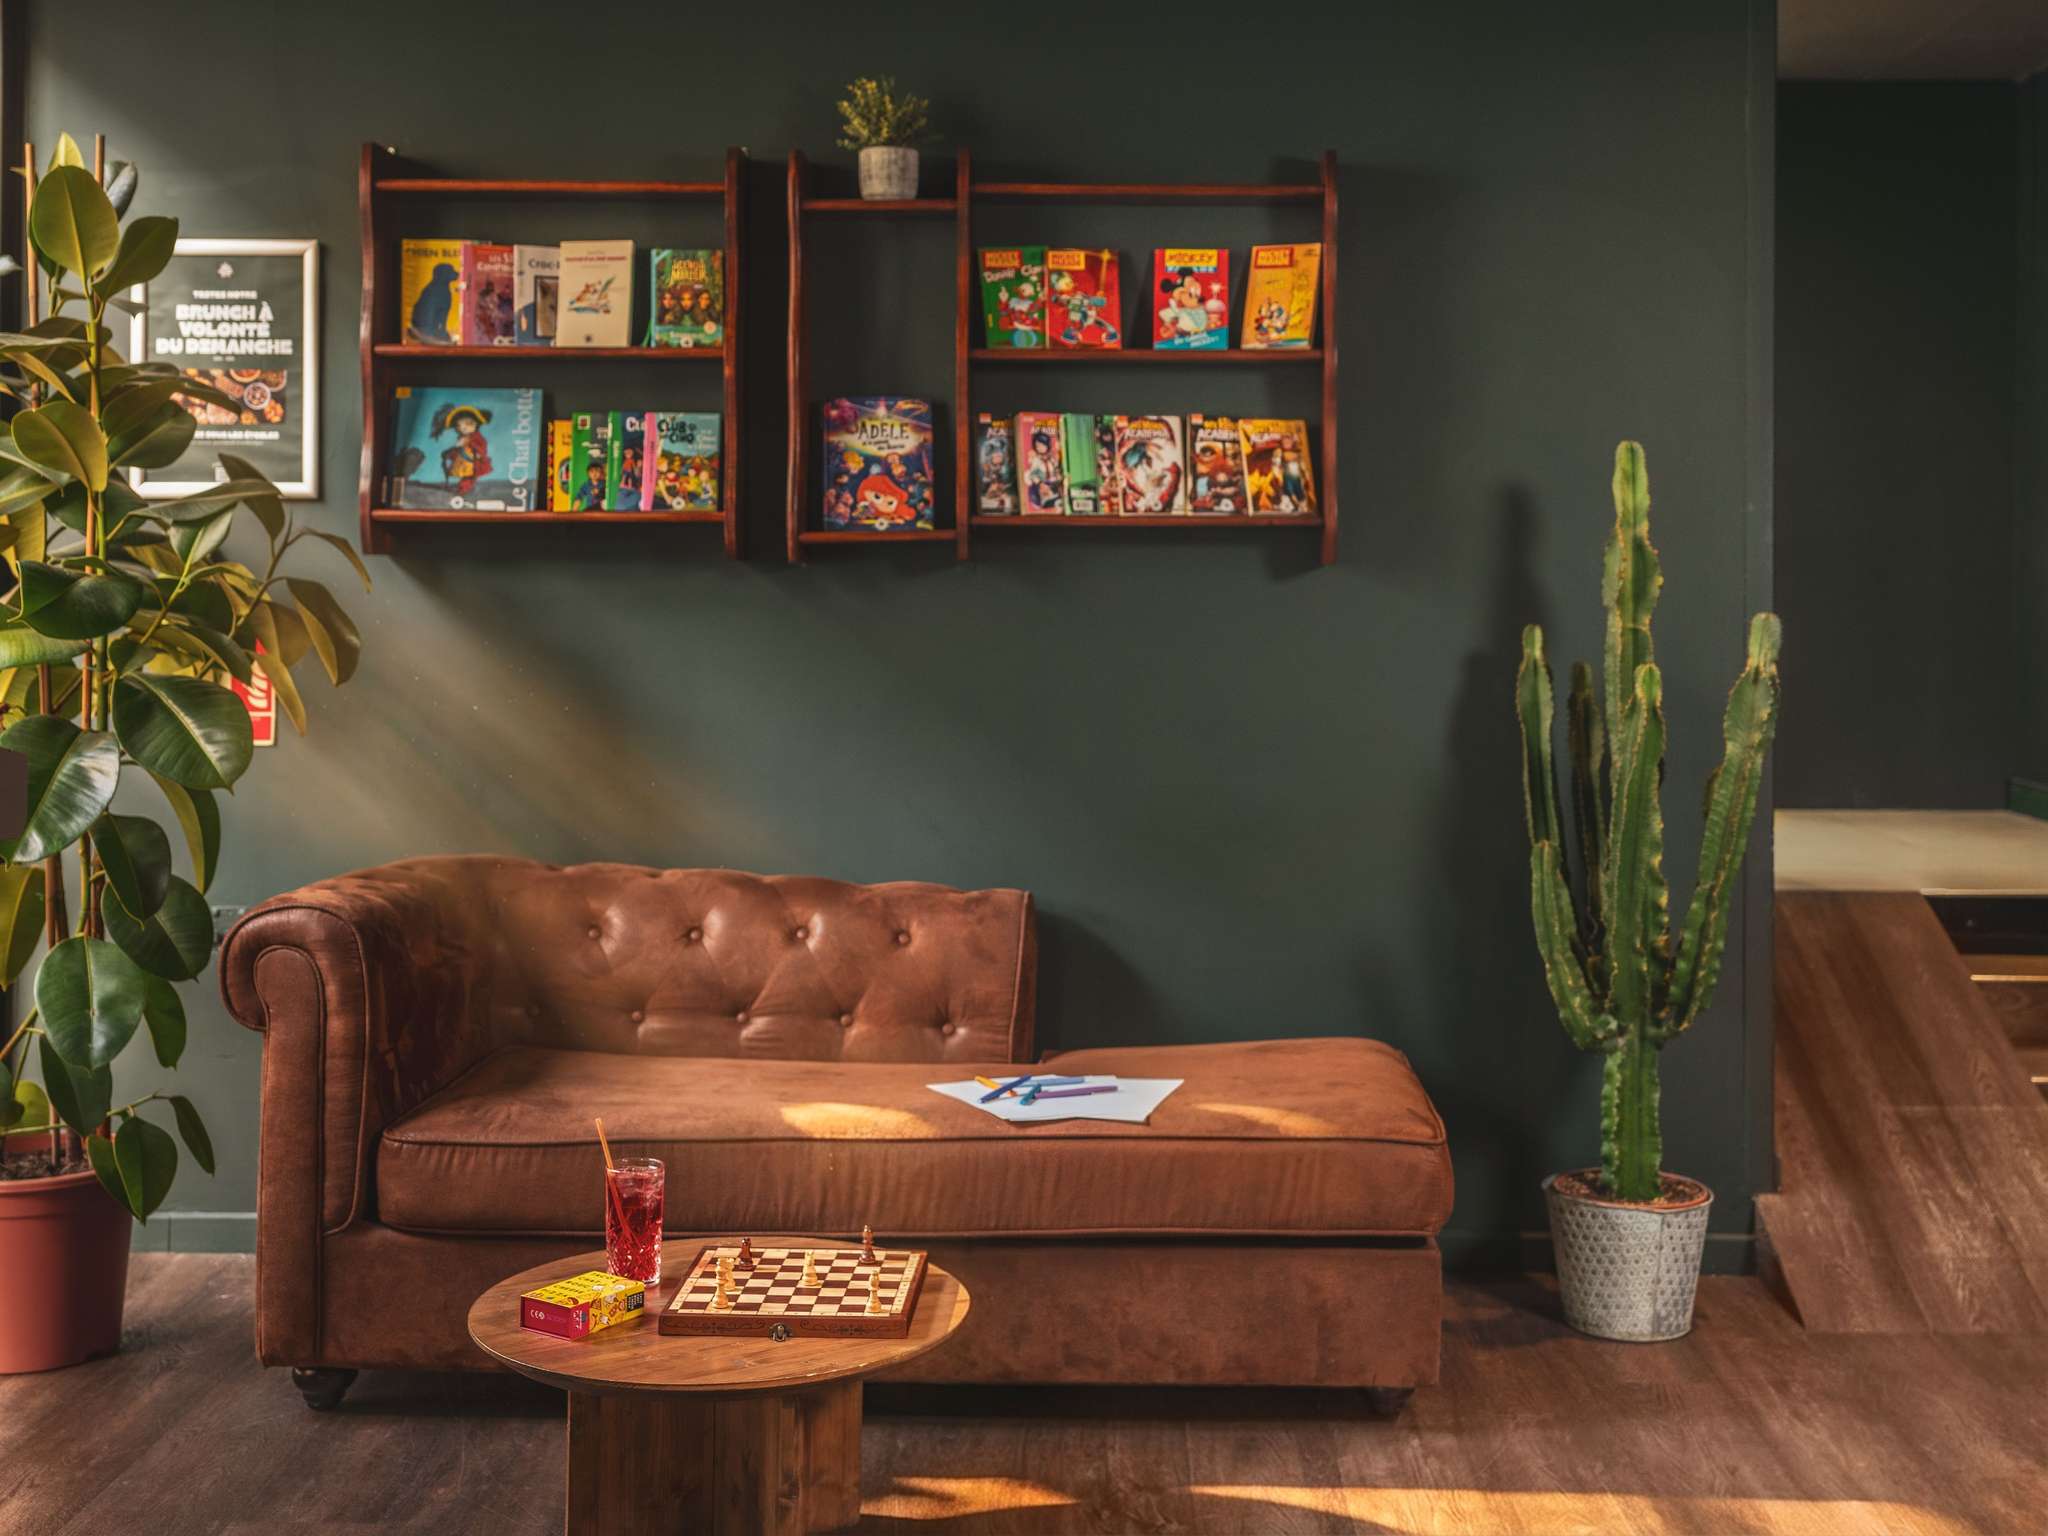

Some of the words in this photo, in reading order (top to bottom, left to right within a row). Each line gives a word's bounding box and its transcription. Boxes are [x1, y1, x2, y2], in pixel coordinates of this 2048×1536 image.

[175, 304, 257, 320] BRUNCH
[258, 300, 274, 320] À
[155, 337, 184, 355] DU
[508, 439, 531, 485] Chat
[506, 486, 528, 512] Le
